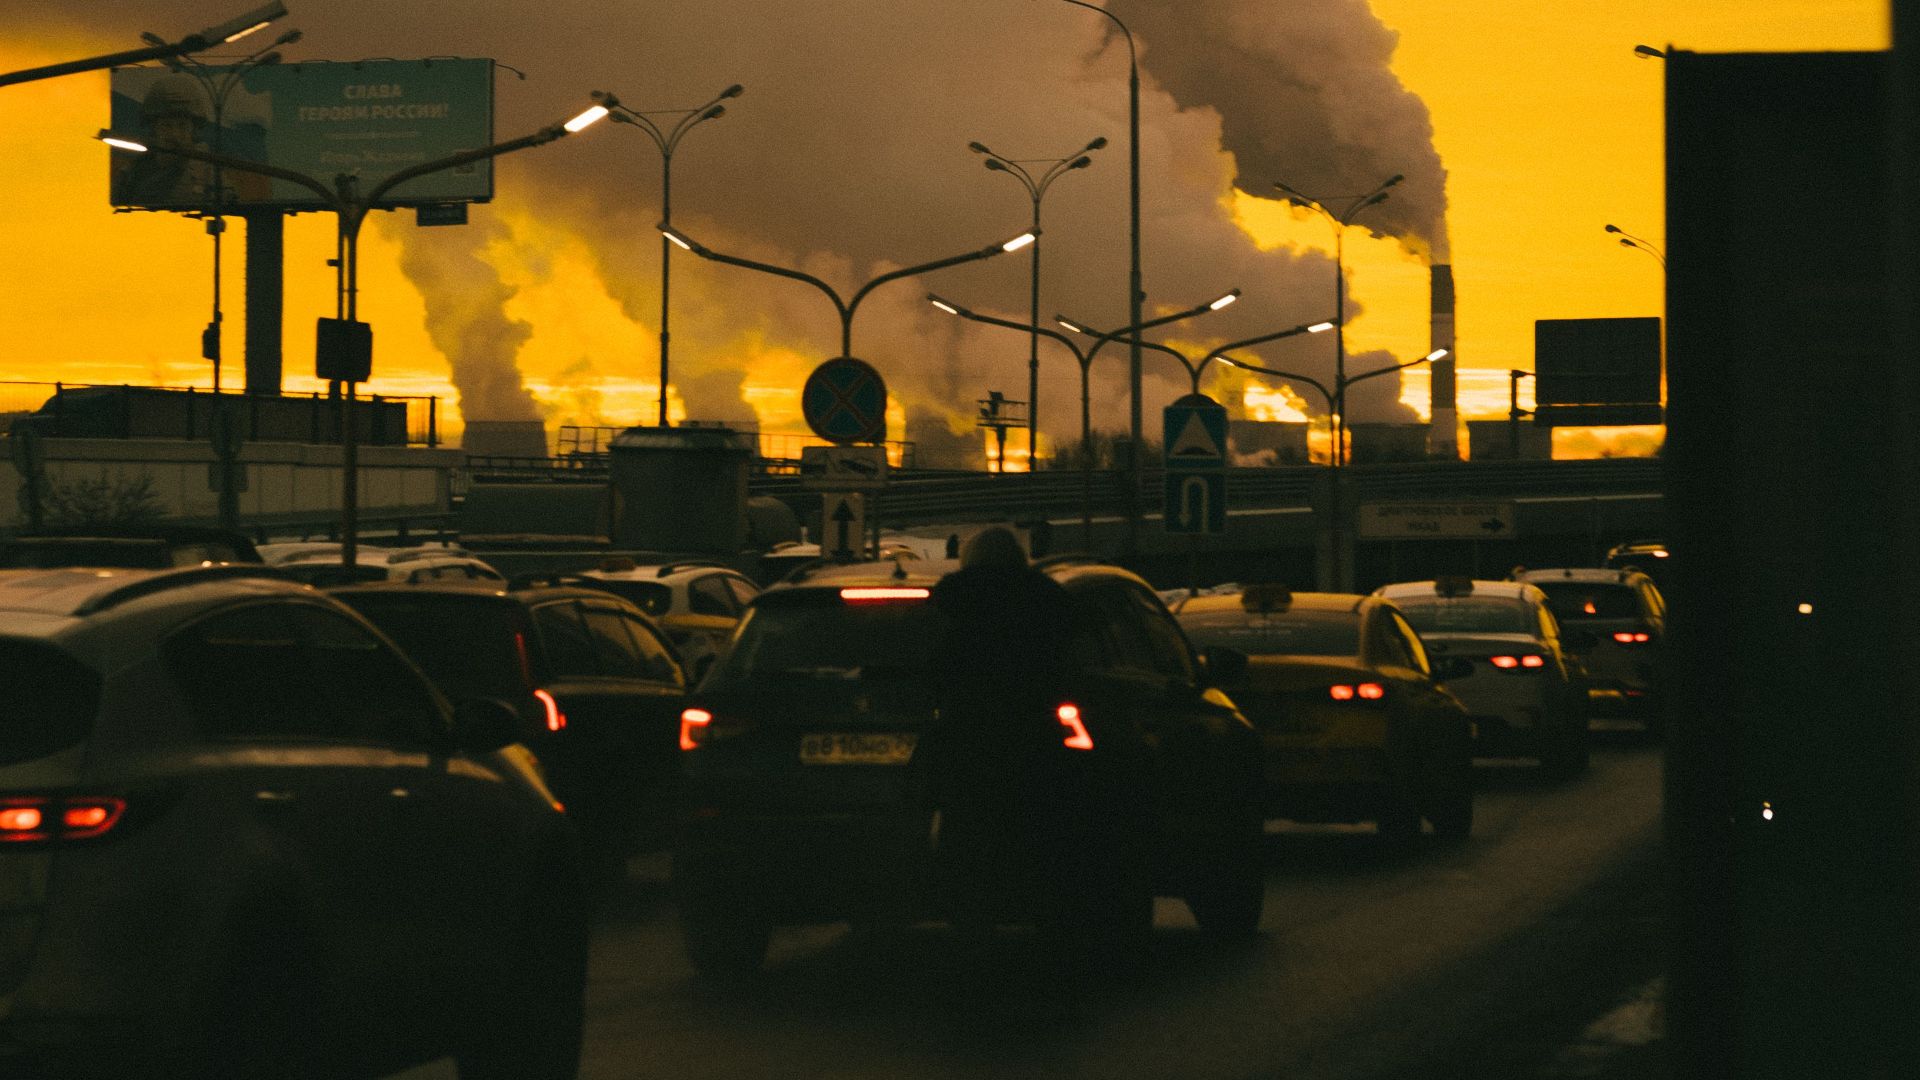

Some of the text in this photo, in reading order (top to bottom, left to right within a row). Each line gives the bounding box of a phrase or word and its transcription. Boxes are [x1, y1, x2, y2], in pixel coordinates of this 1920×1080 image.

[343, 84, 402, 99] СЛАВА
[299, 103, 449, 121] ГЕРОЯМ РОССИИ!
